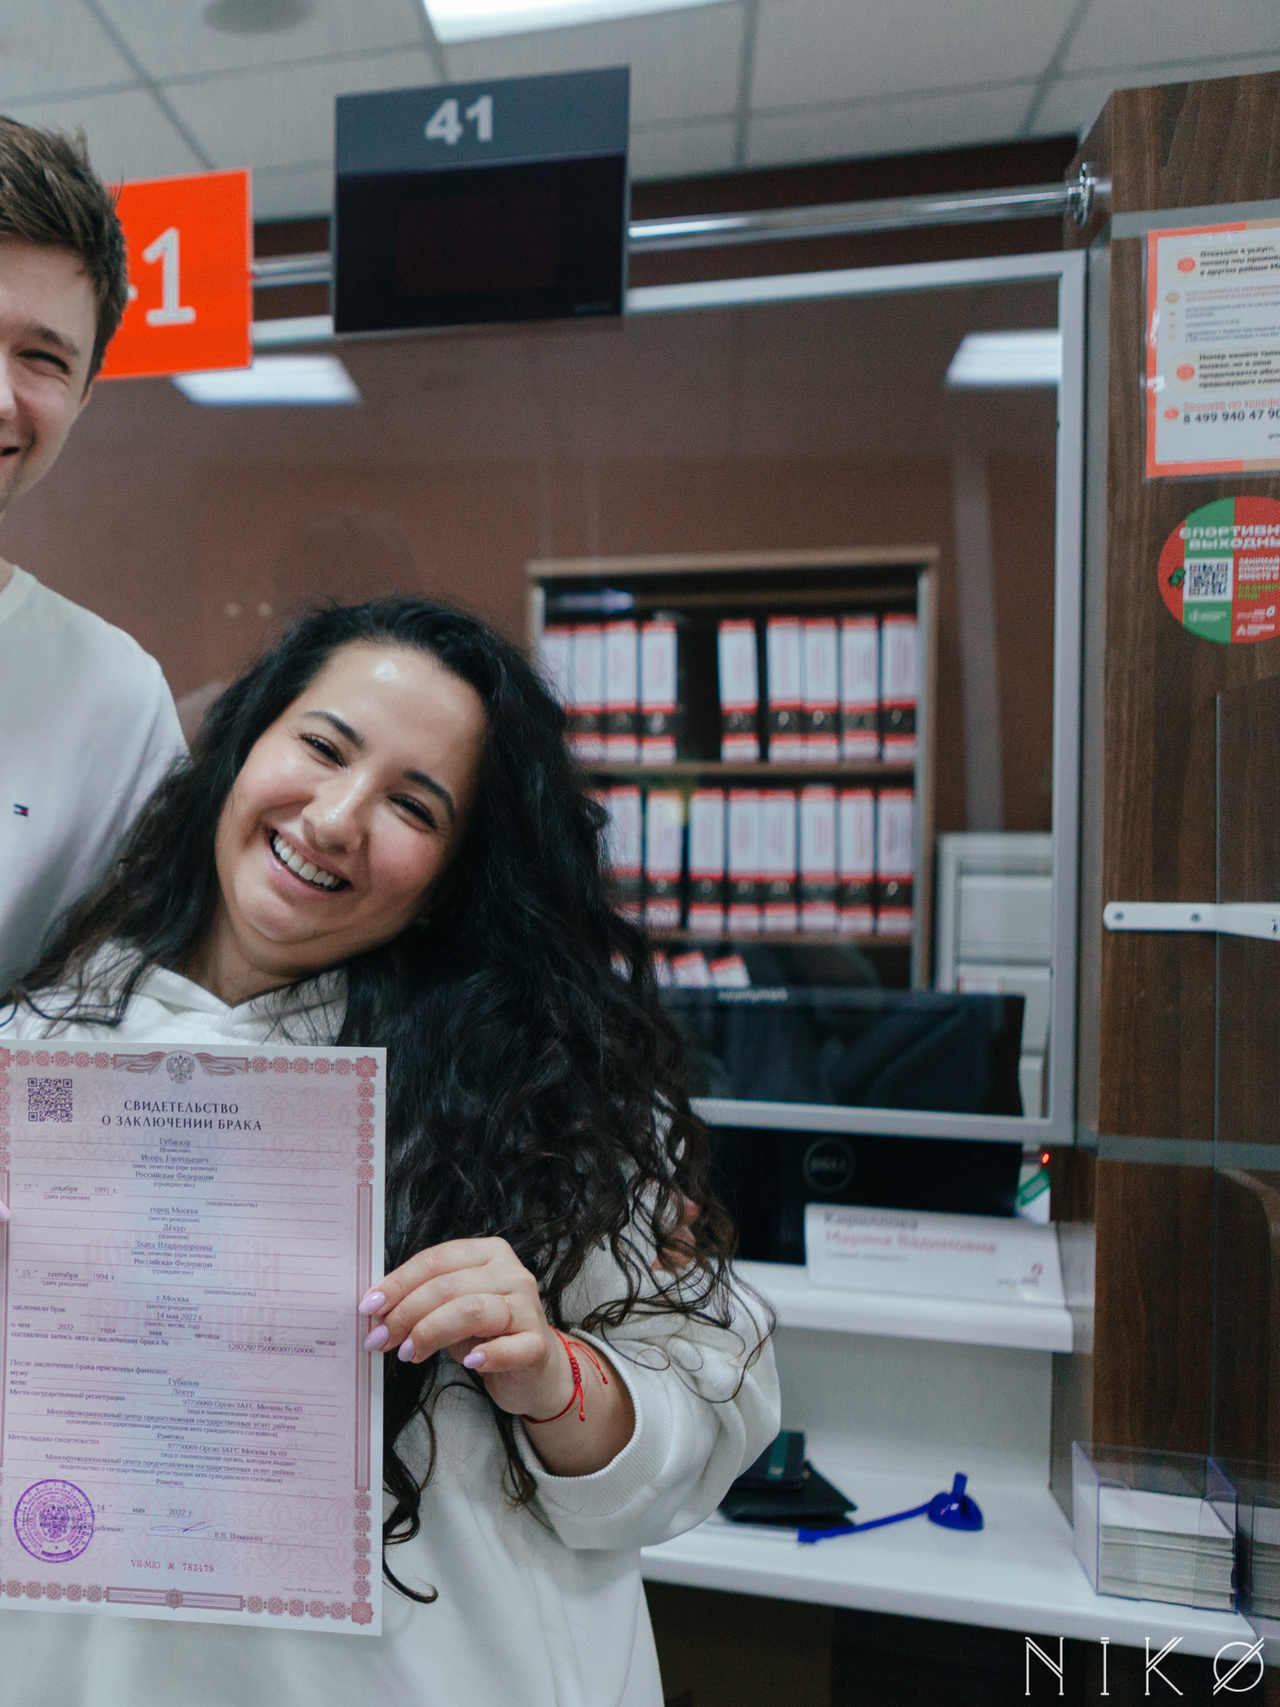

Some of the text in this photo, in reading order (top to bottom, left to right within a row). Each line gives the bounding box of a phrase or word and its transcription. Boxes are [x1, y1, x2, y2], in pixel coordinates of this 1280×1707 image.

[425, 95, 494, 145] 41
[126, 227, 196, 327] 1
[1195, 412, 1218, 422] 499
[1222, 410, 1245, 421] 940
[1250, 409, 1264, 419] 47
[124, 1100, 239, 1115] СВИДЕТЕЛЬСТВО
[102, 1115, 262, 1131] О ЗАКЛЮЧЕНИИ БРАКА
[141, 1154, 164, 1163] Игорь
[136, 1171, 214, 1182] Российская Федерация
[134, 1240, 155, 1248] Злата
[134, 1258, 212, 1268] Российская Федерация
[48, 1271, 78, 1279] сентября
[50, 1305, 66, 1313] брак
[11, 1331, 48, 1339] составлена
[96, 1336, 138, 1344] заключении
[140, 1338, 160, 1346] брака
[10, 1360, 32, 1368] После
[75, 1363, 94, 1371] брака
[96, 1366, 134, 1374] присвоены
[168, 1378, 199, 1387] Губанов
[172, 1388, 194, 1397] Лёкур
[31, 1391, 84, 1400] государственной
[85, 1394, 125, 1402] регистрации
[214, 1400, 234, 1408] Орган
[257, 1404, 283, 1412] Москвы
[46, 1408, 122, 1419] Многофункциональный
[124, 1413, 142, 1421] центр
[144, 1414, 194, 1424] предоставления
[196, 1418, 251, 1427] государственных
[253, 1421, 271, 1429] услуг
[103, 1420, 150, 1430] государственная
[204, 1428, 244, 1436] гражданского
[199, 1445, 220, 1453] Орган
[242, 1448, 268, 1456] Москвы
[143, 1460, 194, 1468] предоставления
[196, 1464, 251, 1472] государственных
[253, 1467, 270, 1475] услуг
[182, 1563, 214, 1573] 783479
